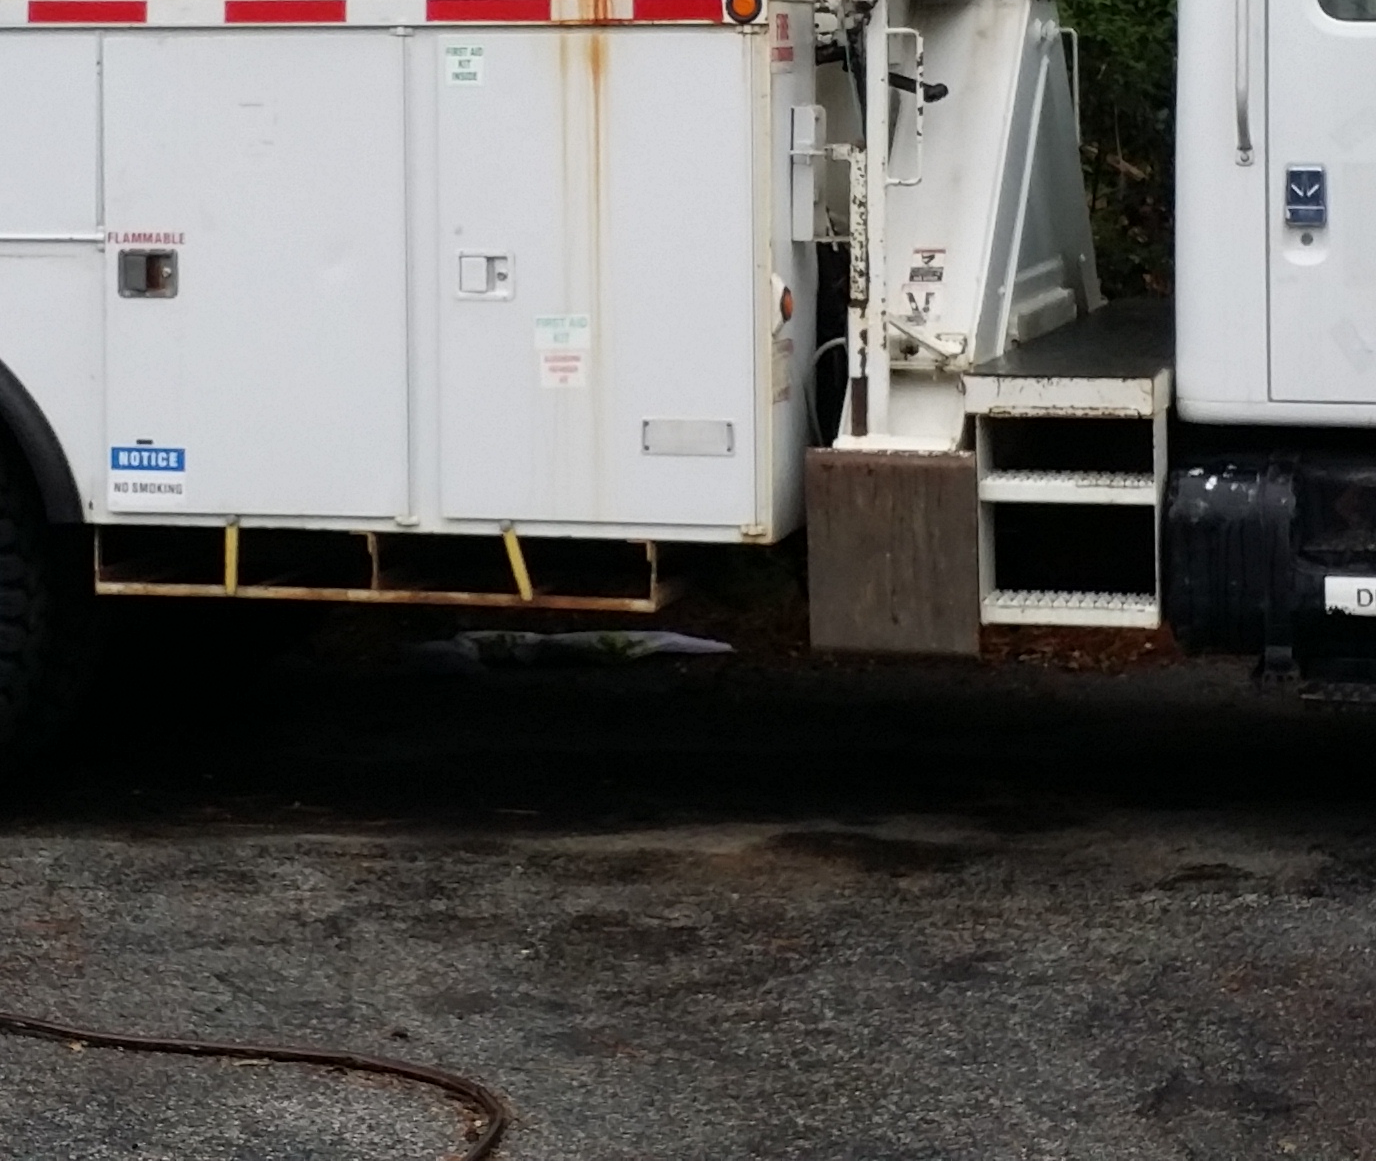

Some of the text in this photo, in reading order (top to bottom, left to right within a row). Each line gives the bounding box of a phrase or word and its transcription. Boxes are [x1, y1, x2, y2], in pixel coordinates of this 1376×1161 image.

[470, 47, 484, 56] AID
[458, 59, 471, 69] KIT
[107, 232, 185, 244] FLAMMABLE
[118, 451, 179, 467] NOTICE
[114, 482, 183, 495] NO SMOKING
